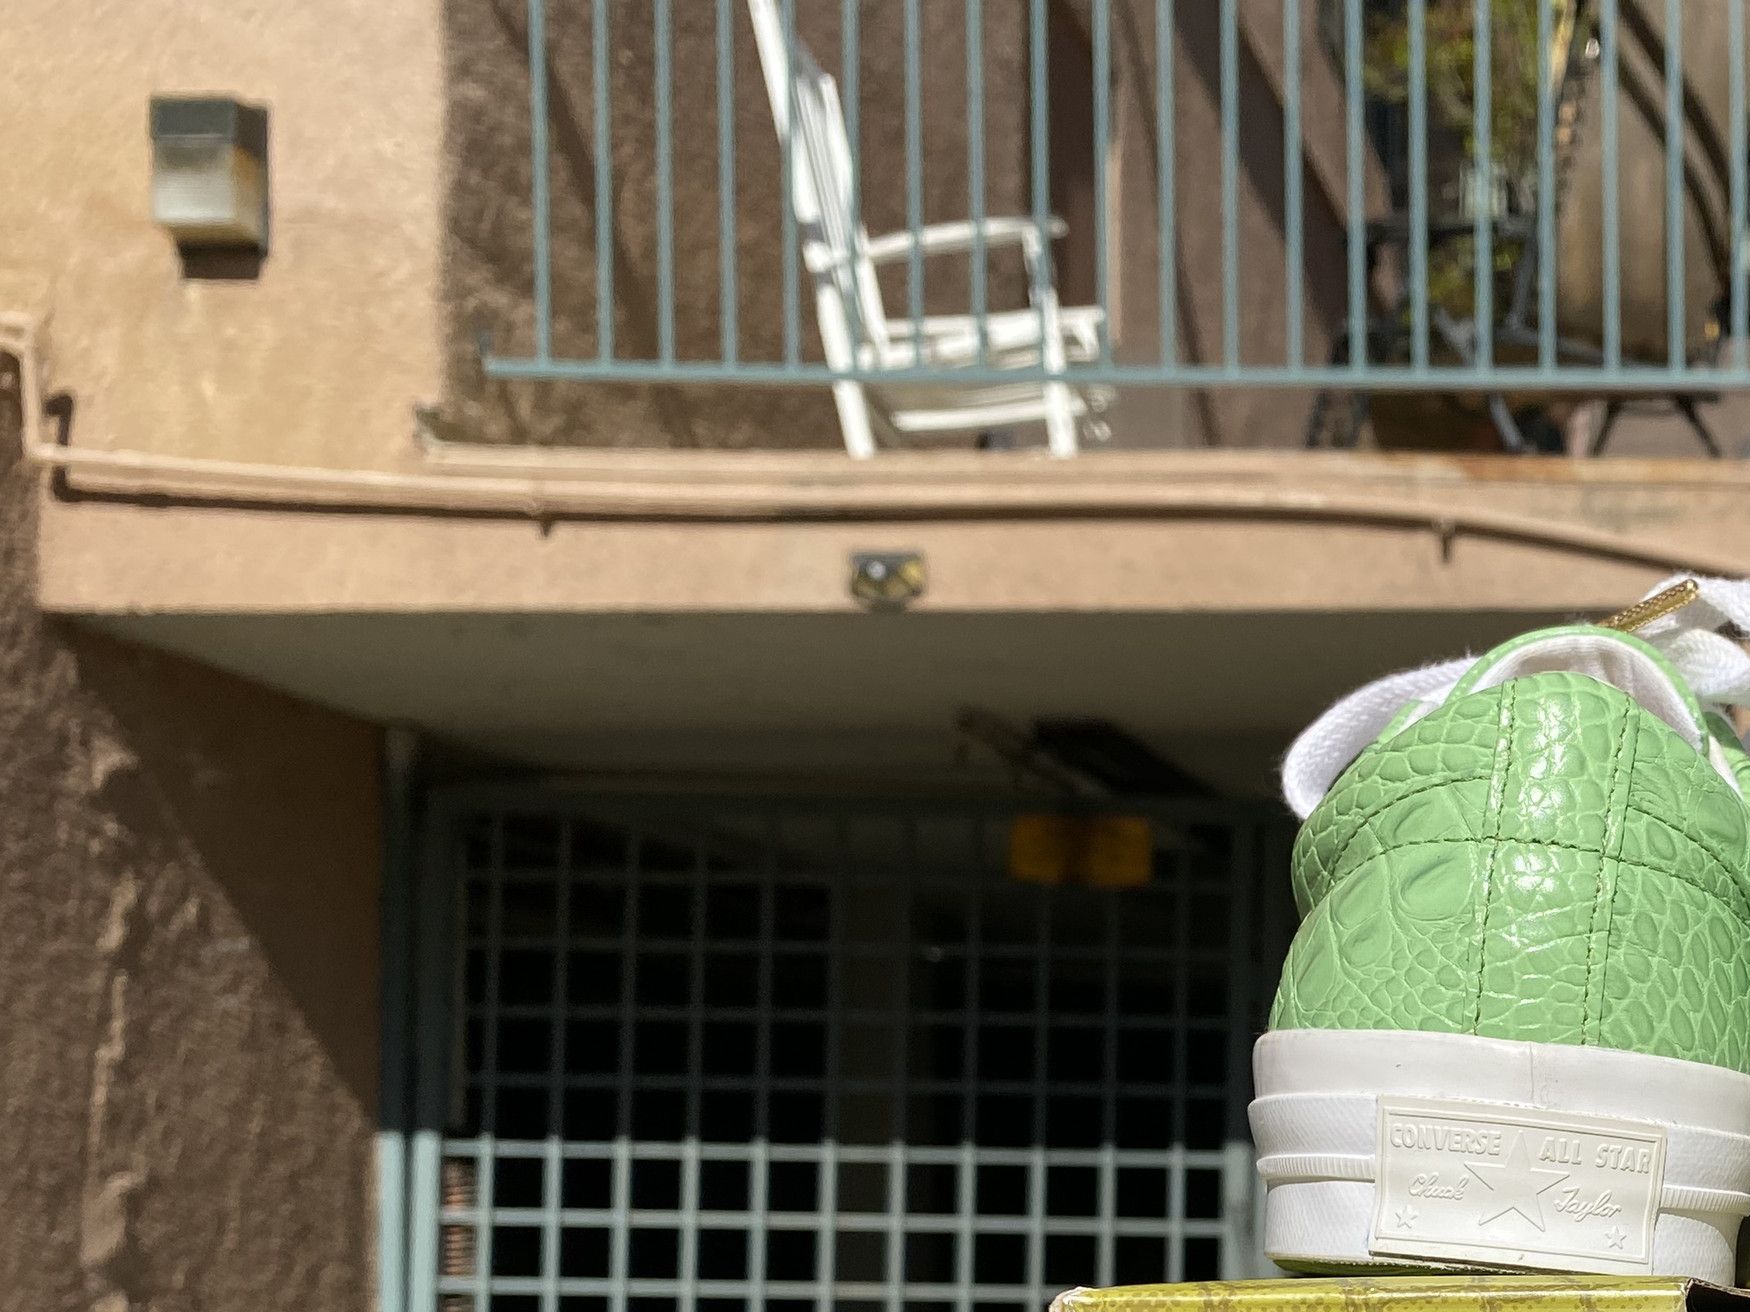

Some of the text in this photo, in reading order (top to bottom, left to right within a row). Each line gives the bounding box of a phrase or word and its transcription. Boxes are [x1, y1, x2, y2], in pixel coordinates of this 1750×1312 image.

[1389, 1122, 1651, 1175] CONVERSE ALL STAR
[1407, 1171, 1623, 1223] Chuck Taylor
